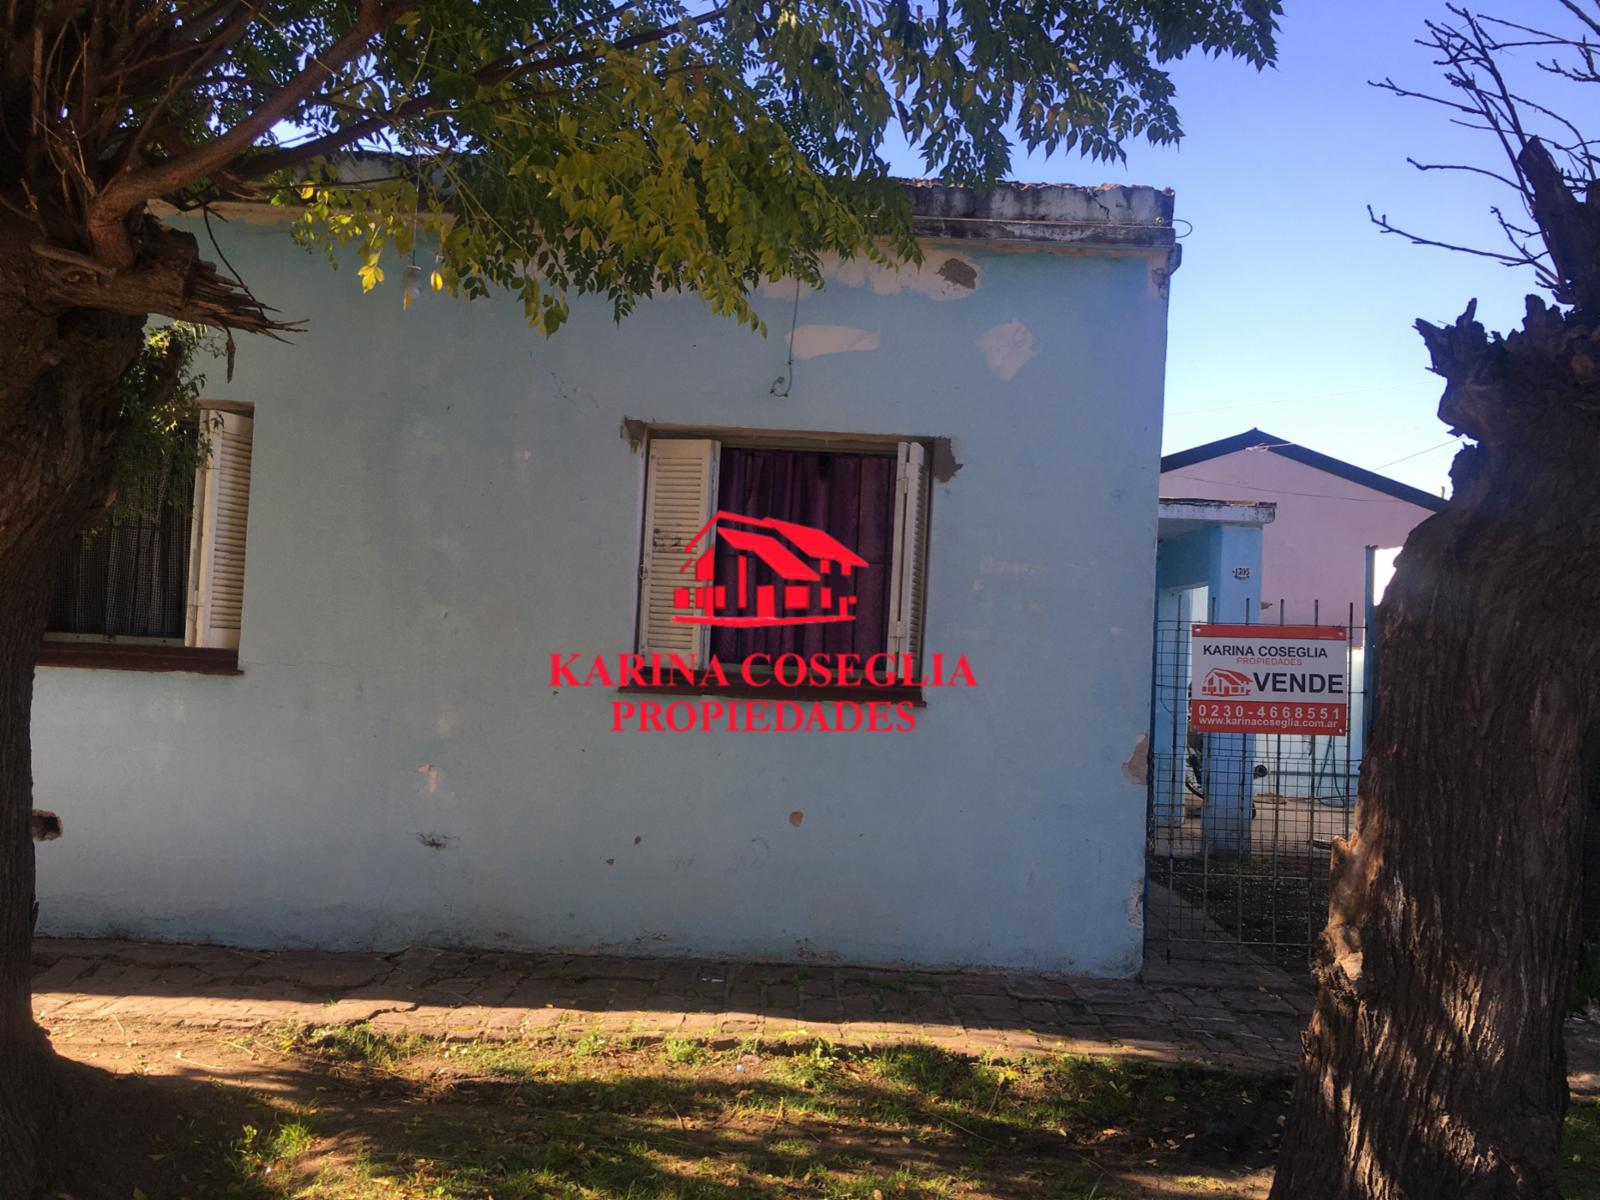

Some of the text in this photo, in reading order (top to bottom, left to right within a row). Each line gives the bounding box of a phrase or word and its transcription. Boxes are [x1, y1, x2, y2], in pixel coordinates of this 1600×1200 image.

[1203, 645, 1327, 658] KARINA COSEGLIA
[1236, 658, 1302, 666] PROPIEDADES
[1253, 672, 1343, 693] VENDE
[1199, 716, 1338, 729] www.karinacoseglia.com.ar
